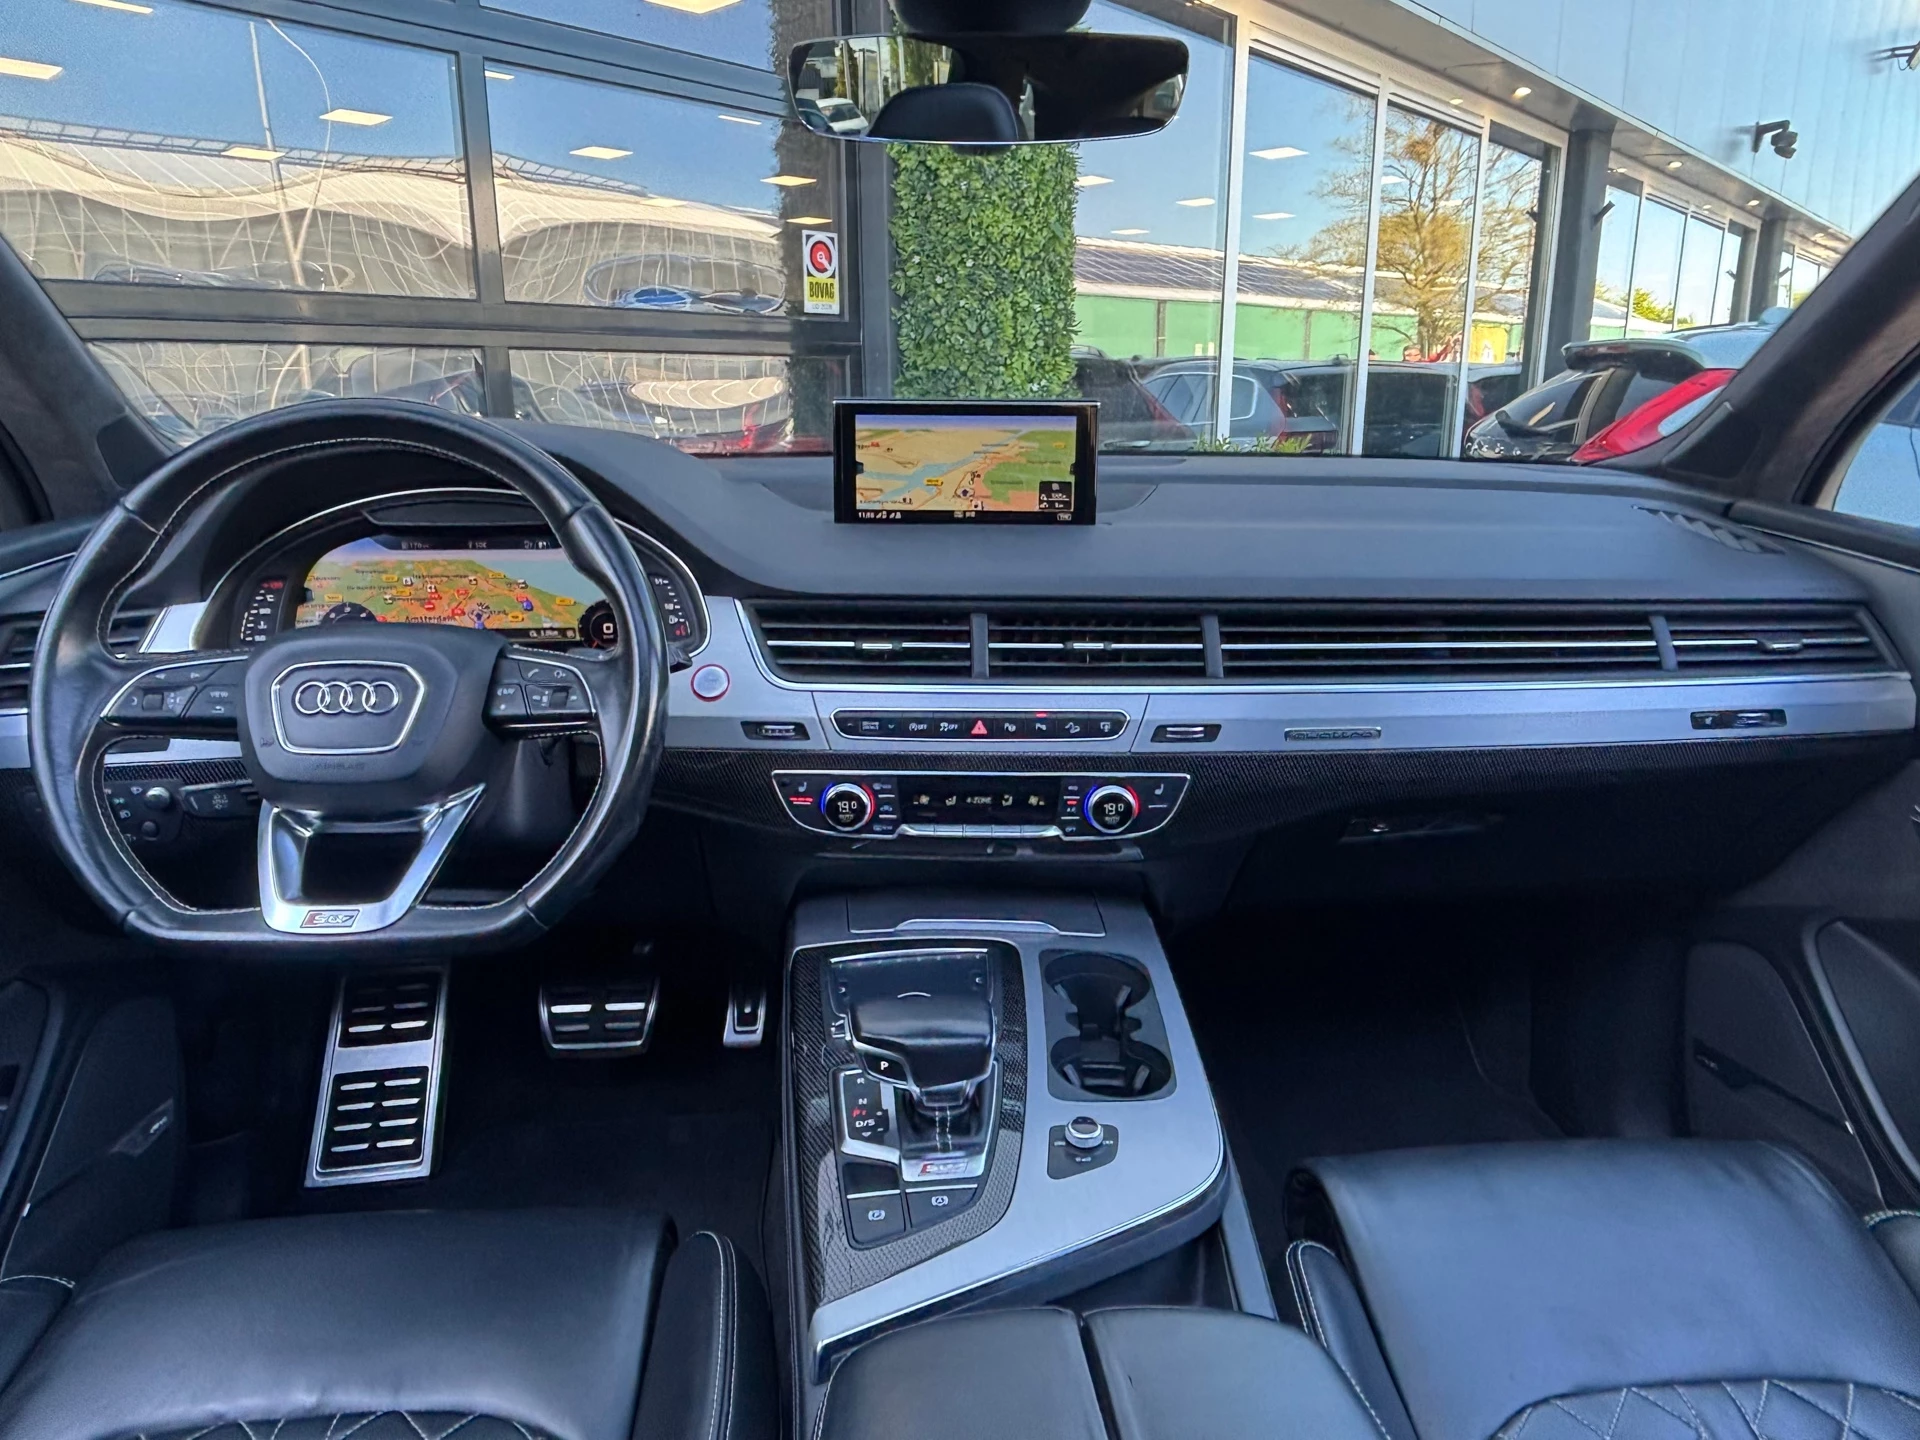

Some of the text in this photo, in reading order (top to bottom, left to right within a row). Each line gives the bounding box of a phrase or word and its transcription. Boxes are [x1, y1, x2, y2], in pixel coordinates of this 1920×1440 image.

[809, 281, 835, 299] BOVAG
[602, 622, 614, 634] 0
[1293, 731, 1374, 740] quattro
[880, 1061, 889, 1071] P
[855, 1118, 876, 1128] D/S
